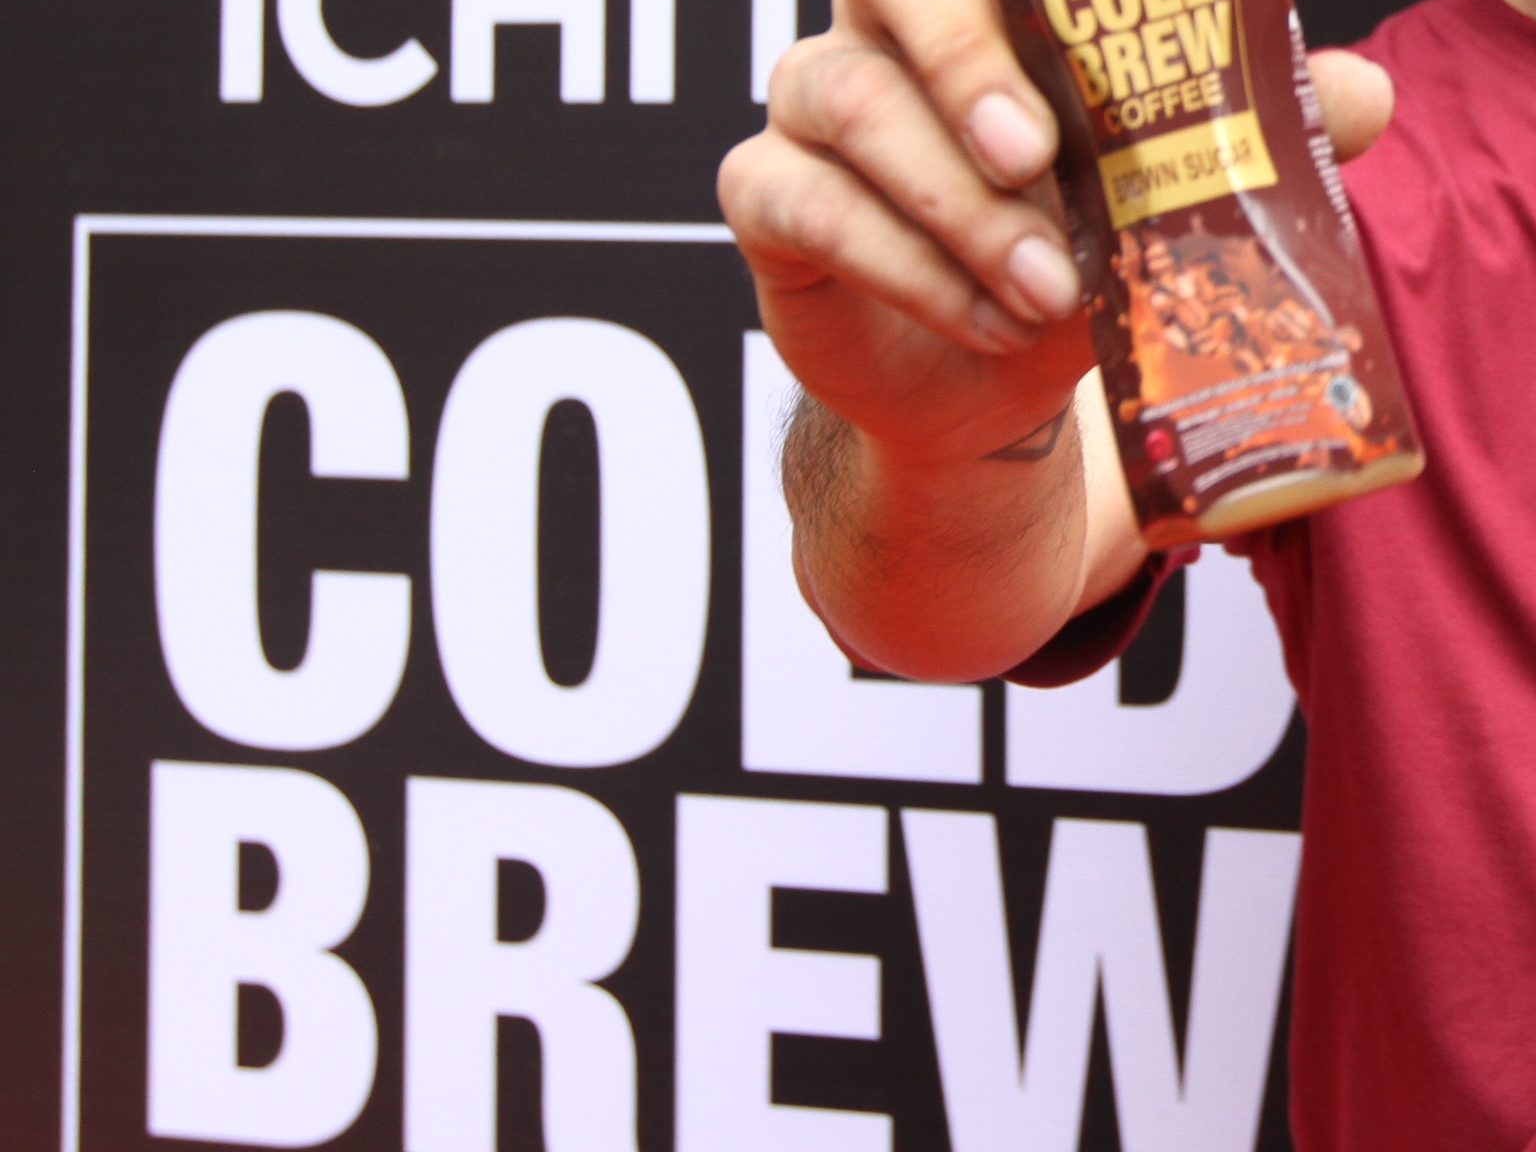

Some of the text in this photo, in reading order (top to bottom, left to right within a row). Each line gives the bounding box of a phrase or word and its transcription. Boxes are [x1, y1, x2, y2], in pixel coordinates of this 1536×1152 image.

[1067, 0, 1232, 108] BREW
[1104, 71, 1225, 135] COFFEE
[146, 759, 1303, 1152] BREW
